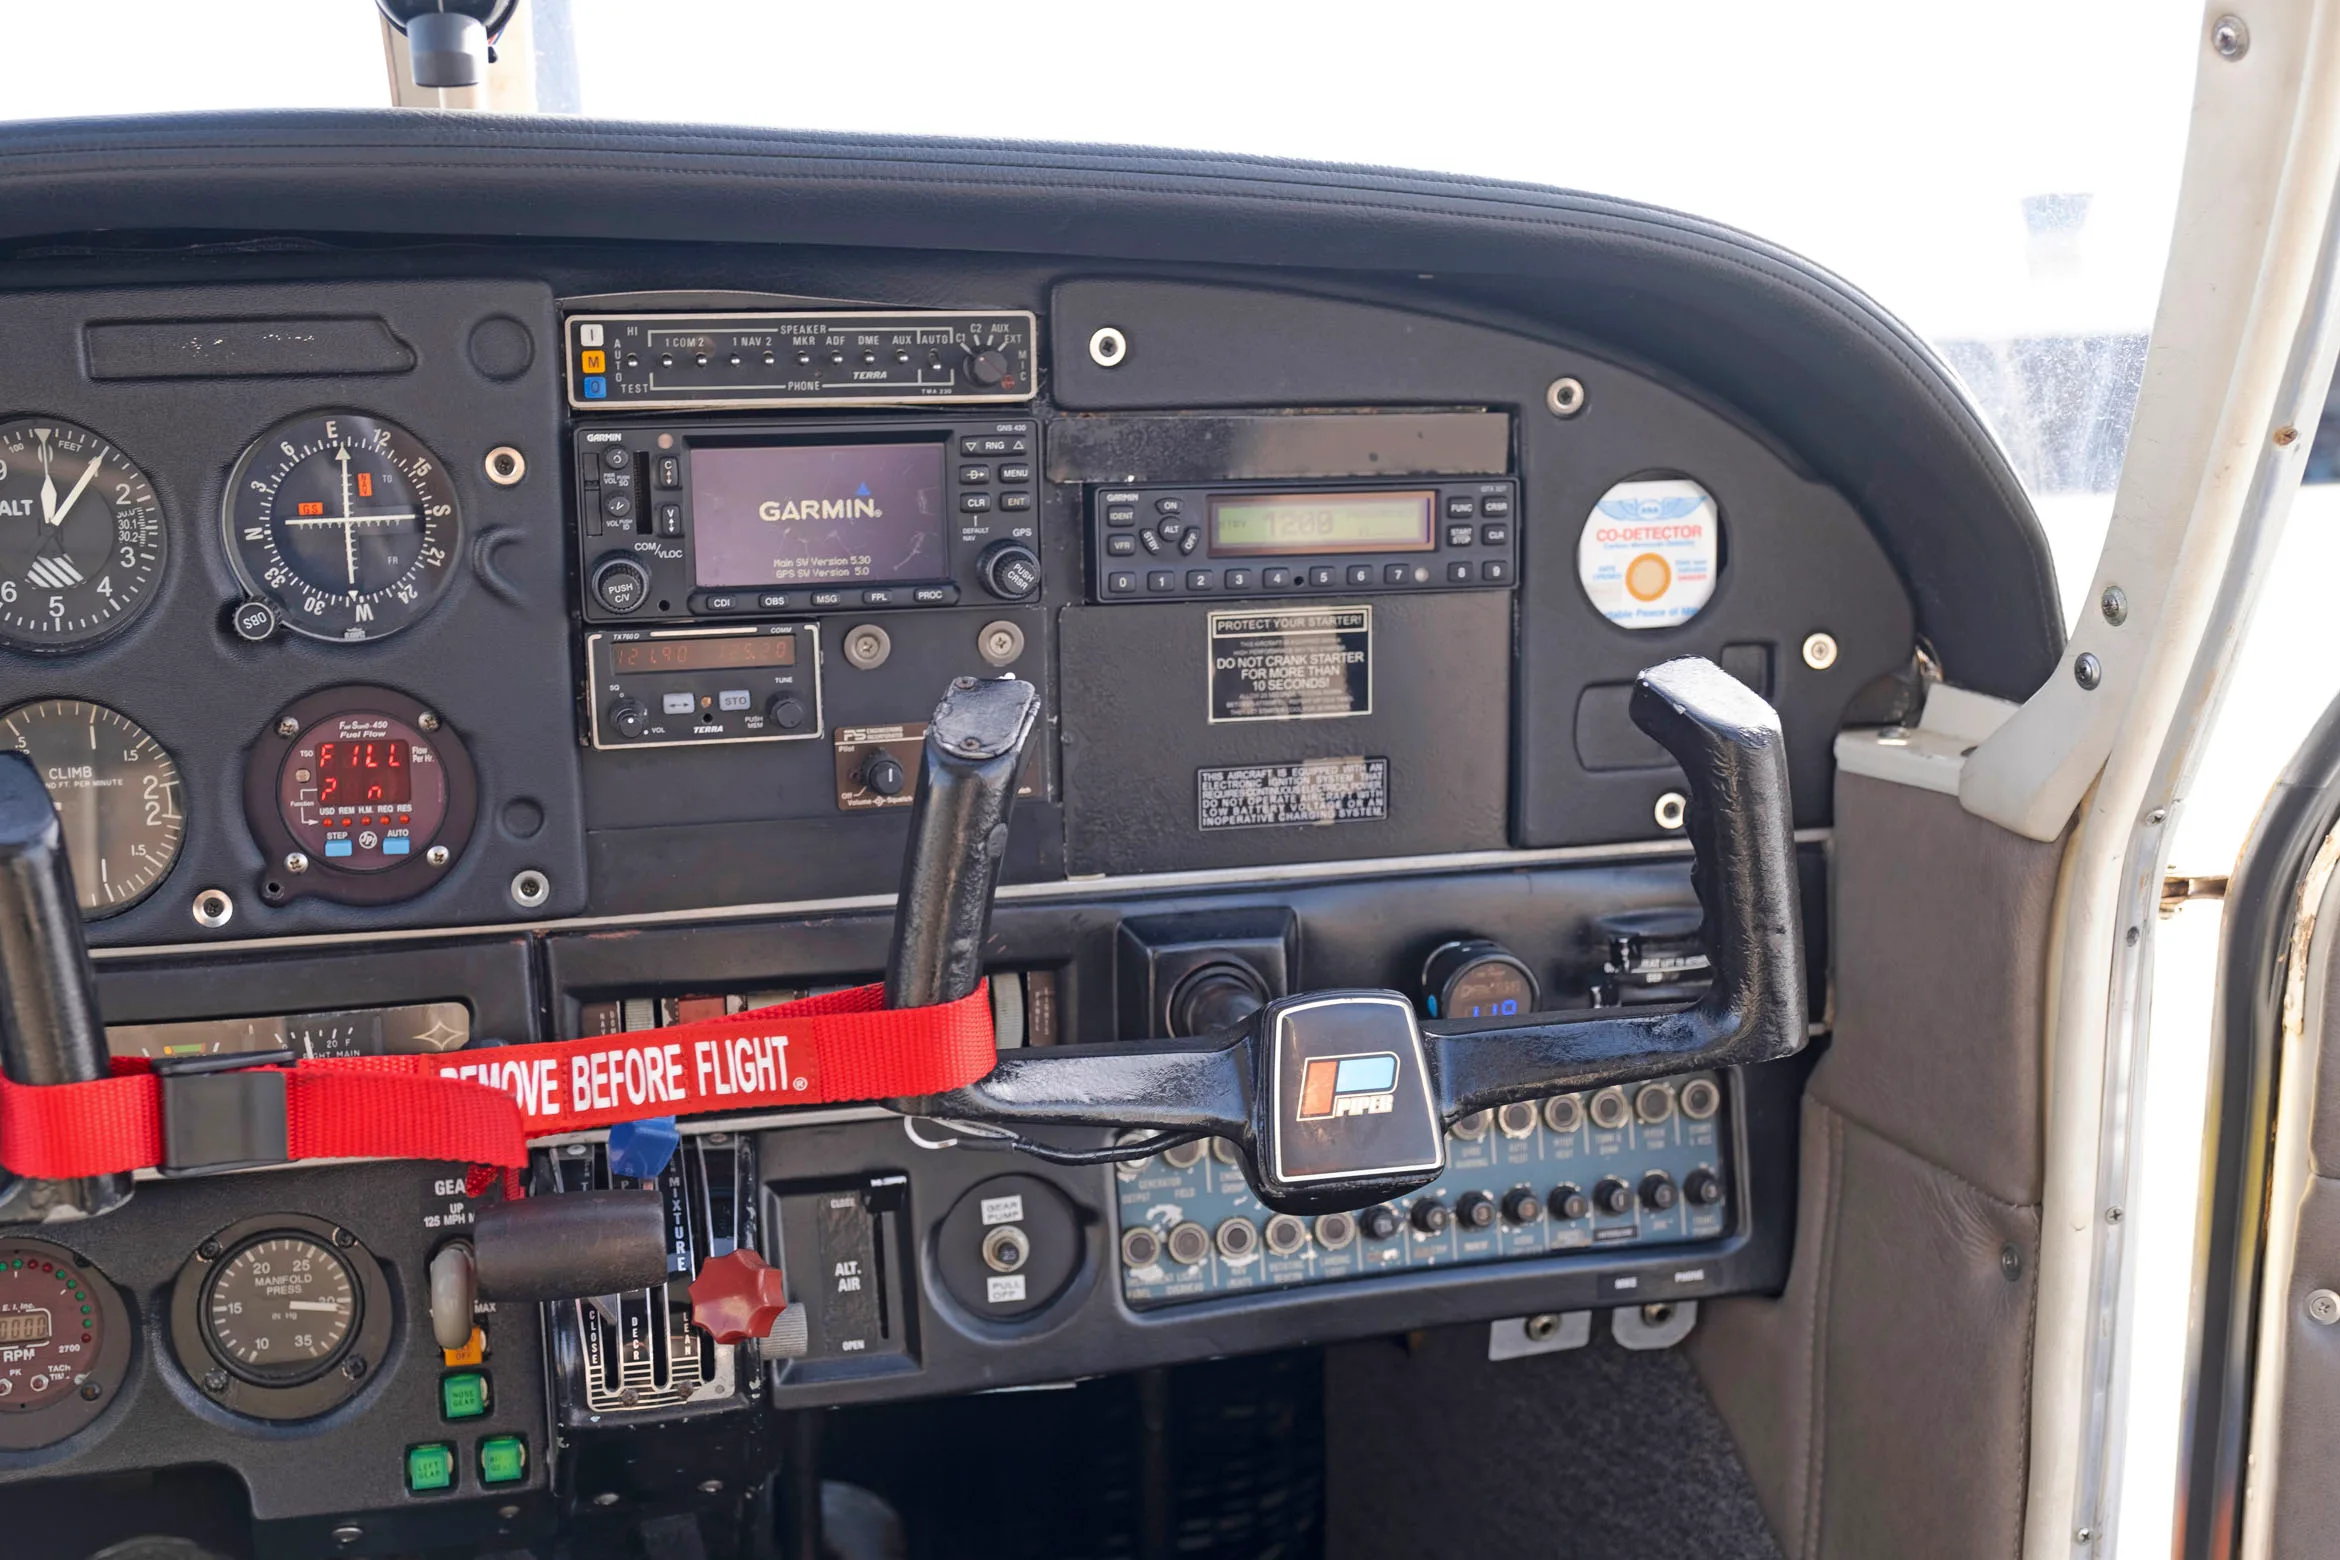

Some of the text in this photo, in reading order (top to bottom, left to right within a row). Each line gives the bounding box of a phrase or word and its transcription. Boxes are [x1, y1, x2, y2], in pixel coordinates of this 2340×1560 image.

[627, 327, 638, 336] HI
[780, 325, 827, 336] SPEAKER
[991, 324, 1009, 332] AUX
[673, 337, 695, 347] COM
[741, 337, 761, 346] NAV
[793, 336, 815, 345] MKR
[826, 336, 846, 345] ADF
[858, 336, 879, 345] DME
[892, 335, 911, 345] AUX
[921, 335, 948, 344] AUTO
[1005, 334, 1022, 343] EXT
[614, 339, 622, 382] AUTO
[1018, 351, 1027, 381] MIC
[853, 371, 887, 379] TERRA
[621, 384, 648, 394] TEST
[787, 380, 820, 391] PHONE
[326, 421, 338, 438] E
[587, 434, 621, 442] GARMIN
[9, 443, 24, 453] 100
[58, 441, 83, 452] FEET
[985, 442, 1004, 450] RNG
[1004, 469, 1028, 478] MENU
[116, 484, 131, 505] 2
[1107, 494, 1139, 502] GARMIN
[968, 499, 985, 507] CLR
[1008, 498, 1025, 506] ENT
[1164, 502, 1178, 510] ON
[1485, 502, 1508, 511] CRSR
[759, 499, 875, 521] GARMIN
[1451, 504, 1473, 512] FUNC
[1110, 512, 1134, 520] IDENT
[118, 519, 137, 529] 30.1
[118, 531, 139, 542] 30.2
[1013, 529, 1032, 537] GPS
[1488, 531, 1504, 539] CLR
[1596, 525, 1702, 542] CO-DETECTOR
[1143, 531, 1159, 552] STBY
[1184, 534, 1198, 550] OFF
[120, 547, 135, 568] 3
[811, 555, 871, 566] Version 5.30
[776, 567, 869, 578] GPS Version 5.0
[1012, 562, 1034, 582] PUSH
[97, 576, 113, 596] 4
[1007, 571, 1029, 590] CRSR
[608, 583, 633, 594] PUSH
[615, 593, 630, 603] C/V
[817, 594, 838, 604] MSG
[871, 593, 887, 601] FPL
[918, 590, 943, 599] PROC
[49, 596, 65, 617] 5
[713, 599, 731, 607] CDI
[765, 597, 785, 606] OBS
[243, 612, 267, 630] OBS
[1217, 615, 1362, 631] PROTECT YOUR STARTER!
[1217, 652, 1364, 669] DO NOT CRANK STARTER
[1241, 665, 1340, 680] FOR MORE THAN
[775, 676, 793, 684] TUNE
[1252, 678, 1329, 691] 10 SECONDS!
[724, 696, 747, 706] STO
[693, 725, 724, 734] TERRA
[123, 750, 139, 762] 1.5
[49, 766, 92, 780] CLIMB
[1202, 772, 1223, 781] THIS
[1227, 770, 1273, 780] AIRCRAFT
[1369, 763, 1383, 772] AN
[143, 775, 159, 799] 2
[1202, 779, 1263, 790] ELECTRONIC
[1202, 800, 1218, 808] DO
[1221, 798, 1243, 807] NOT
[1247, 794, 1297, 805] OPERATE
[145, 801, 162, 826] 2
[338, 807, 355, 815] REM
[397, 804, 412, 812] RES
[1202, 799, 1383, 817] LOW BATTERY VOLTAGE OR AN
[1202, 814, 1274, 826] INOPERATIVE
[1278, 810, 1336, 822] CHARGING
[327, 832, 348, 840] STEP
[131, 844, 146, 856] 1.5
[571, 1044, 686, 1112] BEFORE
[695, 1036, 789, 1097] FLIGHT
[1335, 1094, 1394, 1117] PIPER
[449, 1203, 464, 1213] UP
[831, 1198, 855, 1208] CLOSE
[986, 1201, 1018, 1213] GEAR
[424, 1213, 465, 1227] 125 MPH
[987, 1211, 1019, 1222] PUMP
[669, 1177, 686, 1271] MIXTURE
[253, 1262, 270, 1274] 20
[293, 1260, 311, 1271] 25
[834, 1261, 862, 1277] ALT.
[255, 1274, 312, 1286] MANIFOLD
[838, 1277, 861, 1293] AIR
[992, 1281, 1020, 1290] PULL
[266, 1285, 302, 1296] PRESS
[992, 1291, 1016, 1299] OFF
[227, 1303, 242, 1314] 15
[474, 1302, 496, 1313] MAX
[589, 1311, 598, 1364] CLOSE
[632, 1317, 640, 1360] DECR
[683, 1312, 691, 1355] LEAN
[256, 1338, 269, 1349] 10
[294, 1335, 312, 1347] 35
[842, 1340, 865, 1351] OPEN
[59, 1344, 80, 1353] 2700
[3, 1348, 35, 1362] RPM
[453, 1390, 474, 1399] NOSE
